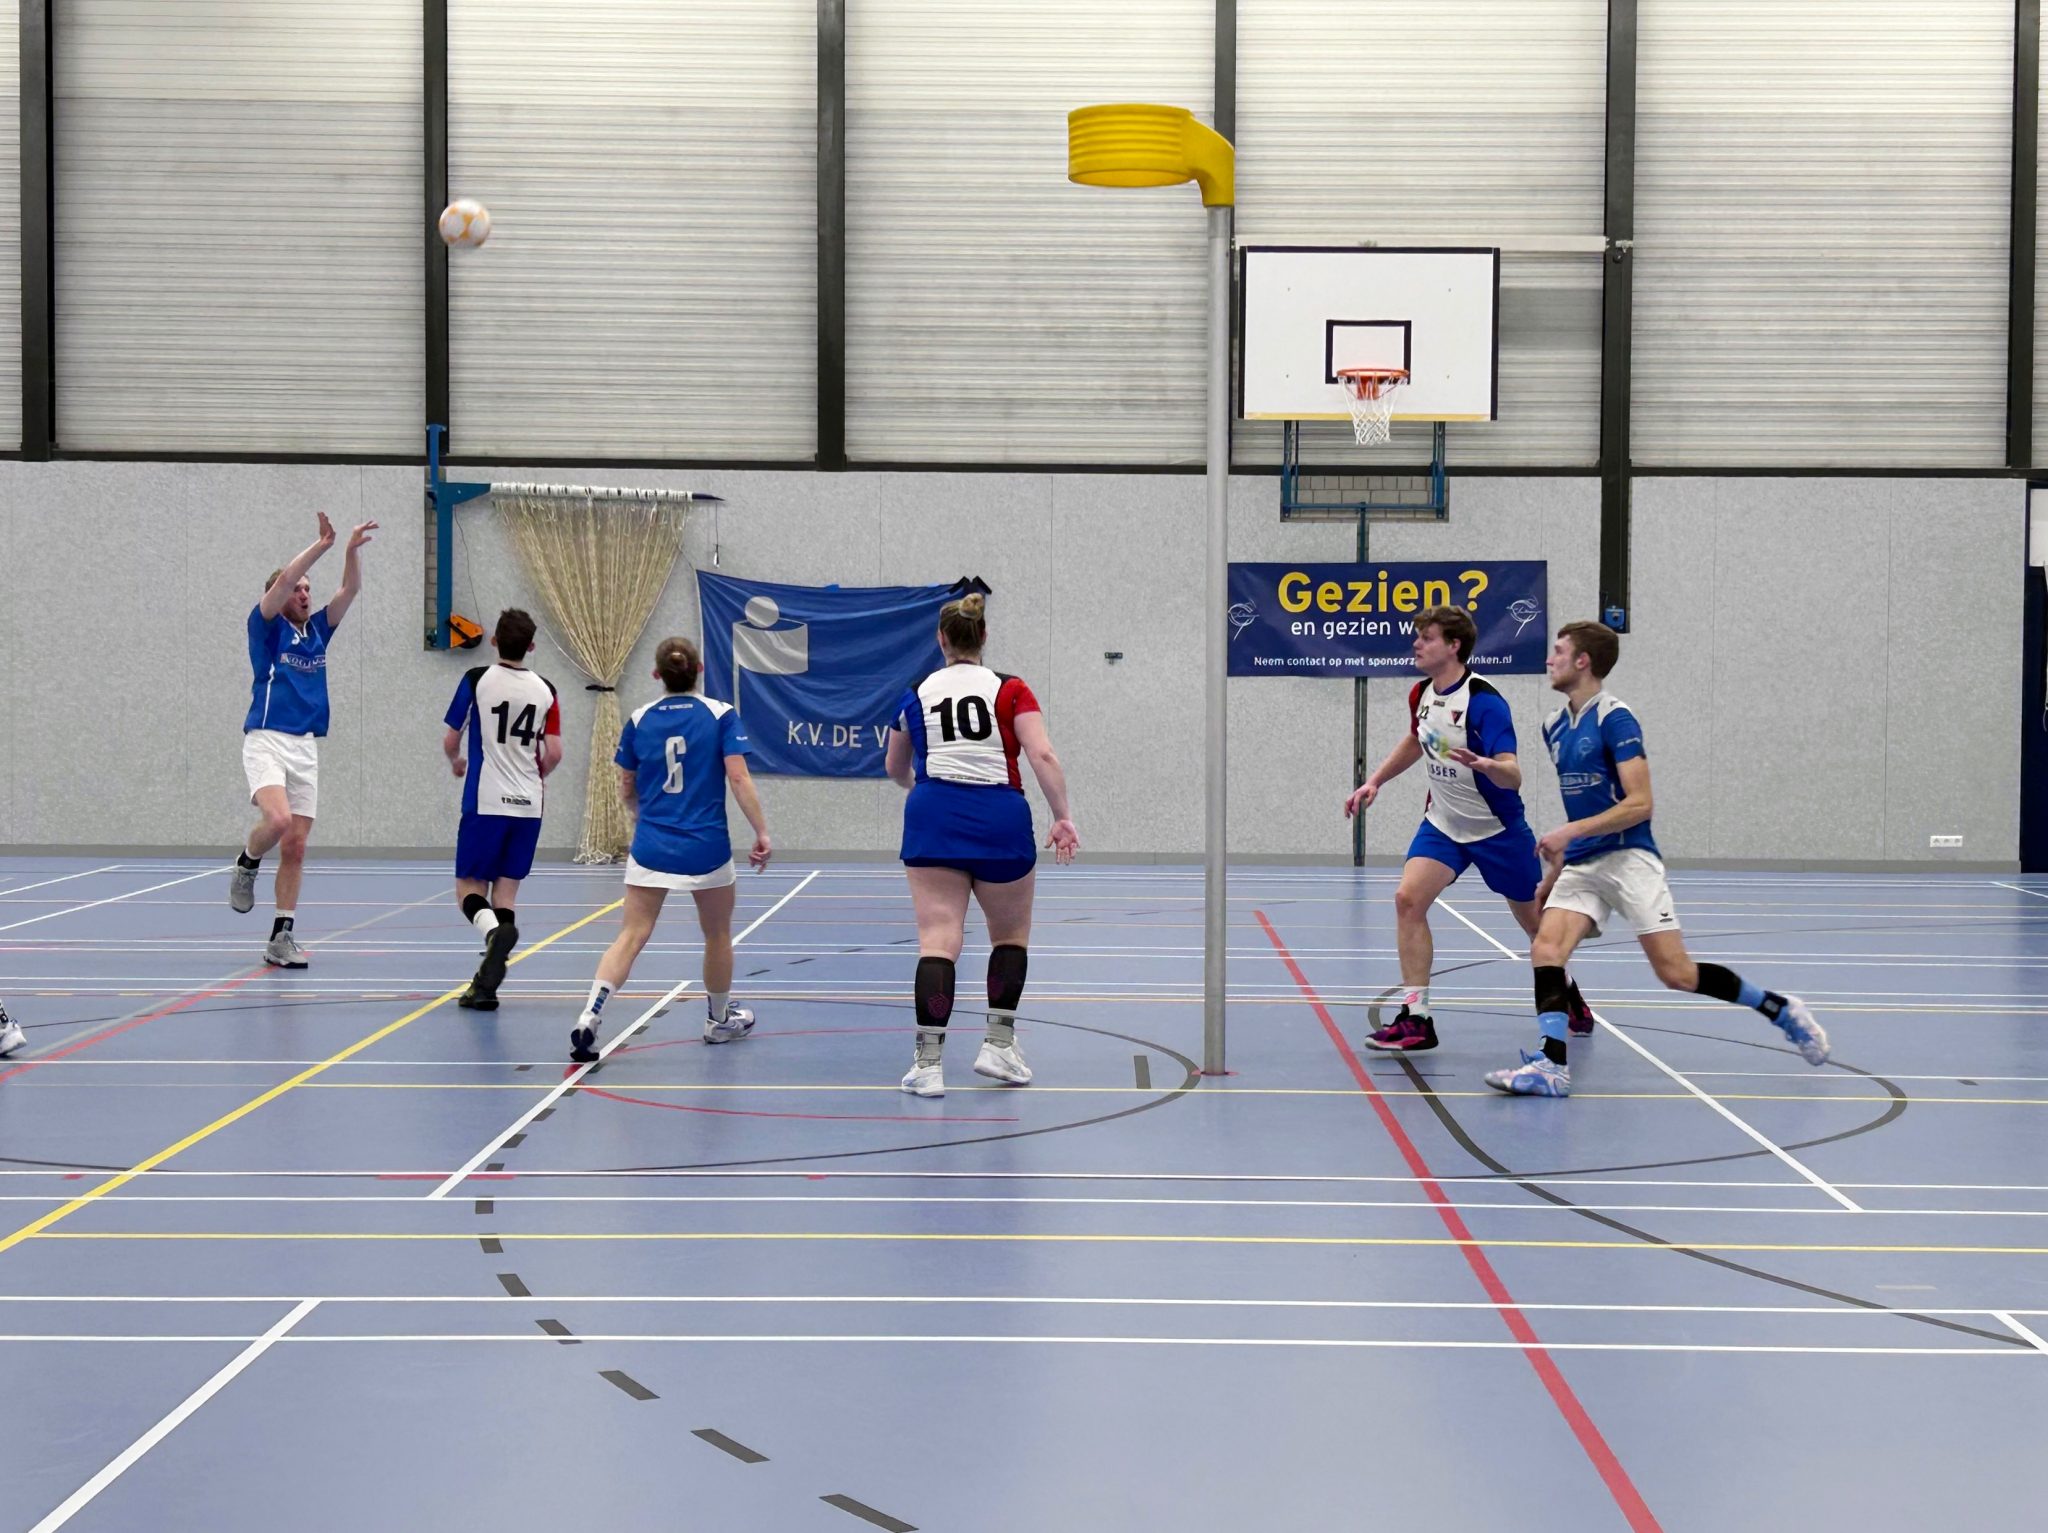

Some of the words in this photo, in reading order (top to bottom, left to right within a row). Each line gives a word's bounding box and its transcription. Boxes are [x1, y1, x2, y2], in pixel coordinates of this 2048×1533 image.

[1291, 622, 1316, 636] en
[1323, 617, 1391, 639] gezien
[1254, 656, 1284, 666] Neem
[1287, 656, 1326, 666] contact
[1329, 657, 1342, 667] op
[1345, 656, 1364, 666] met
[1368, 656, 1415, 667] sponsorz
[491, 700, 536, 746] 14
[930, 695, 993, 742] 10
[787, 721, 824, 747] K.V.
[832, 725, 862, 748] DE
